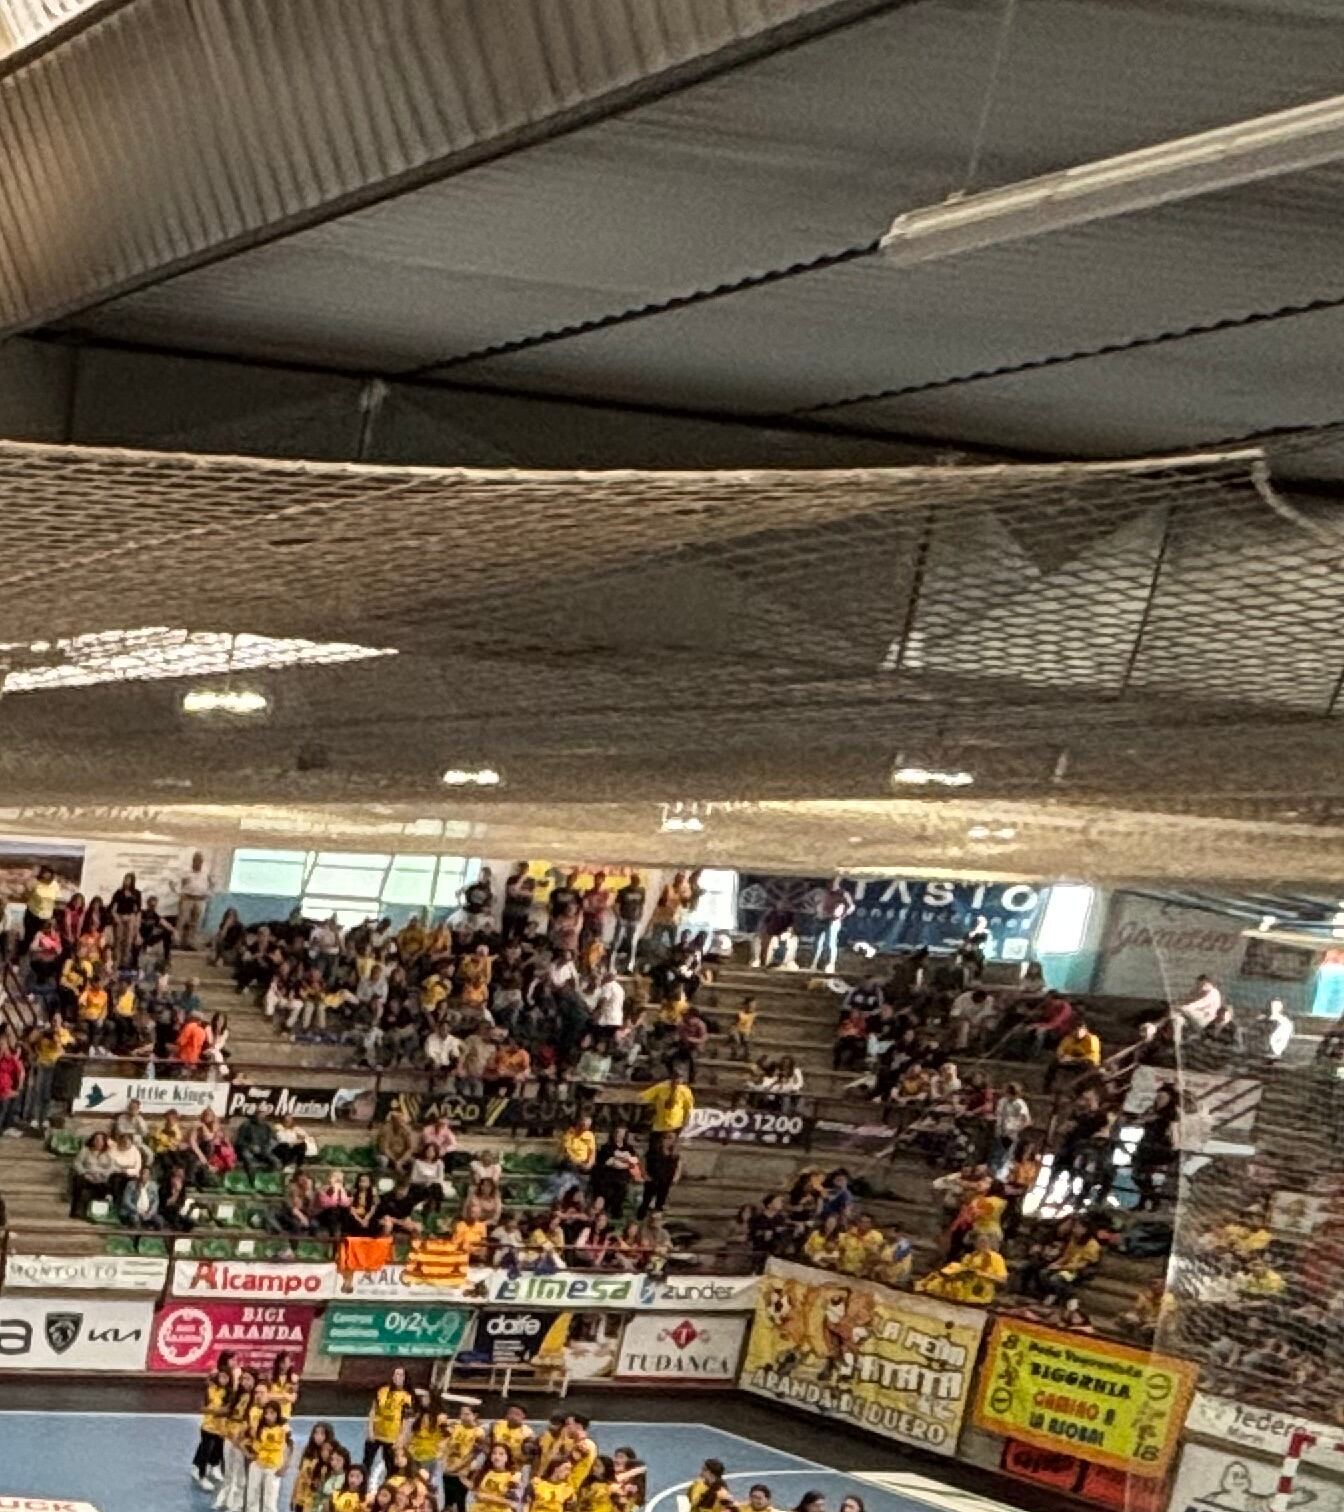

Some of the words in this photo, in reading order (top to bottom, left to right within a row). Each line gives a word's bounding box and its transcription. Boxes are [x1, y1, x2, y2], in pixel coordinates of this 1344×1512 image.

[753, 1114, 803, 1135] 1200
[189, 1262, 322, 1296] Alcampo
[216, 1324, 303, 1341] ARANDA
[625, 1352, 729, 1373] TUDANCA
[867, 1401, 948, 1445] DUERO
